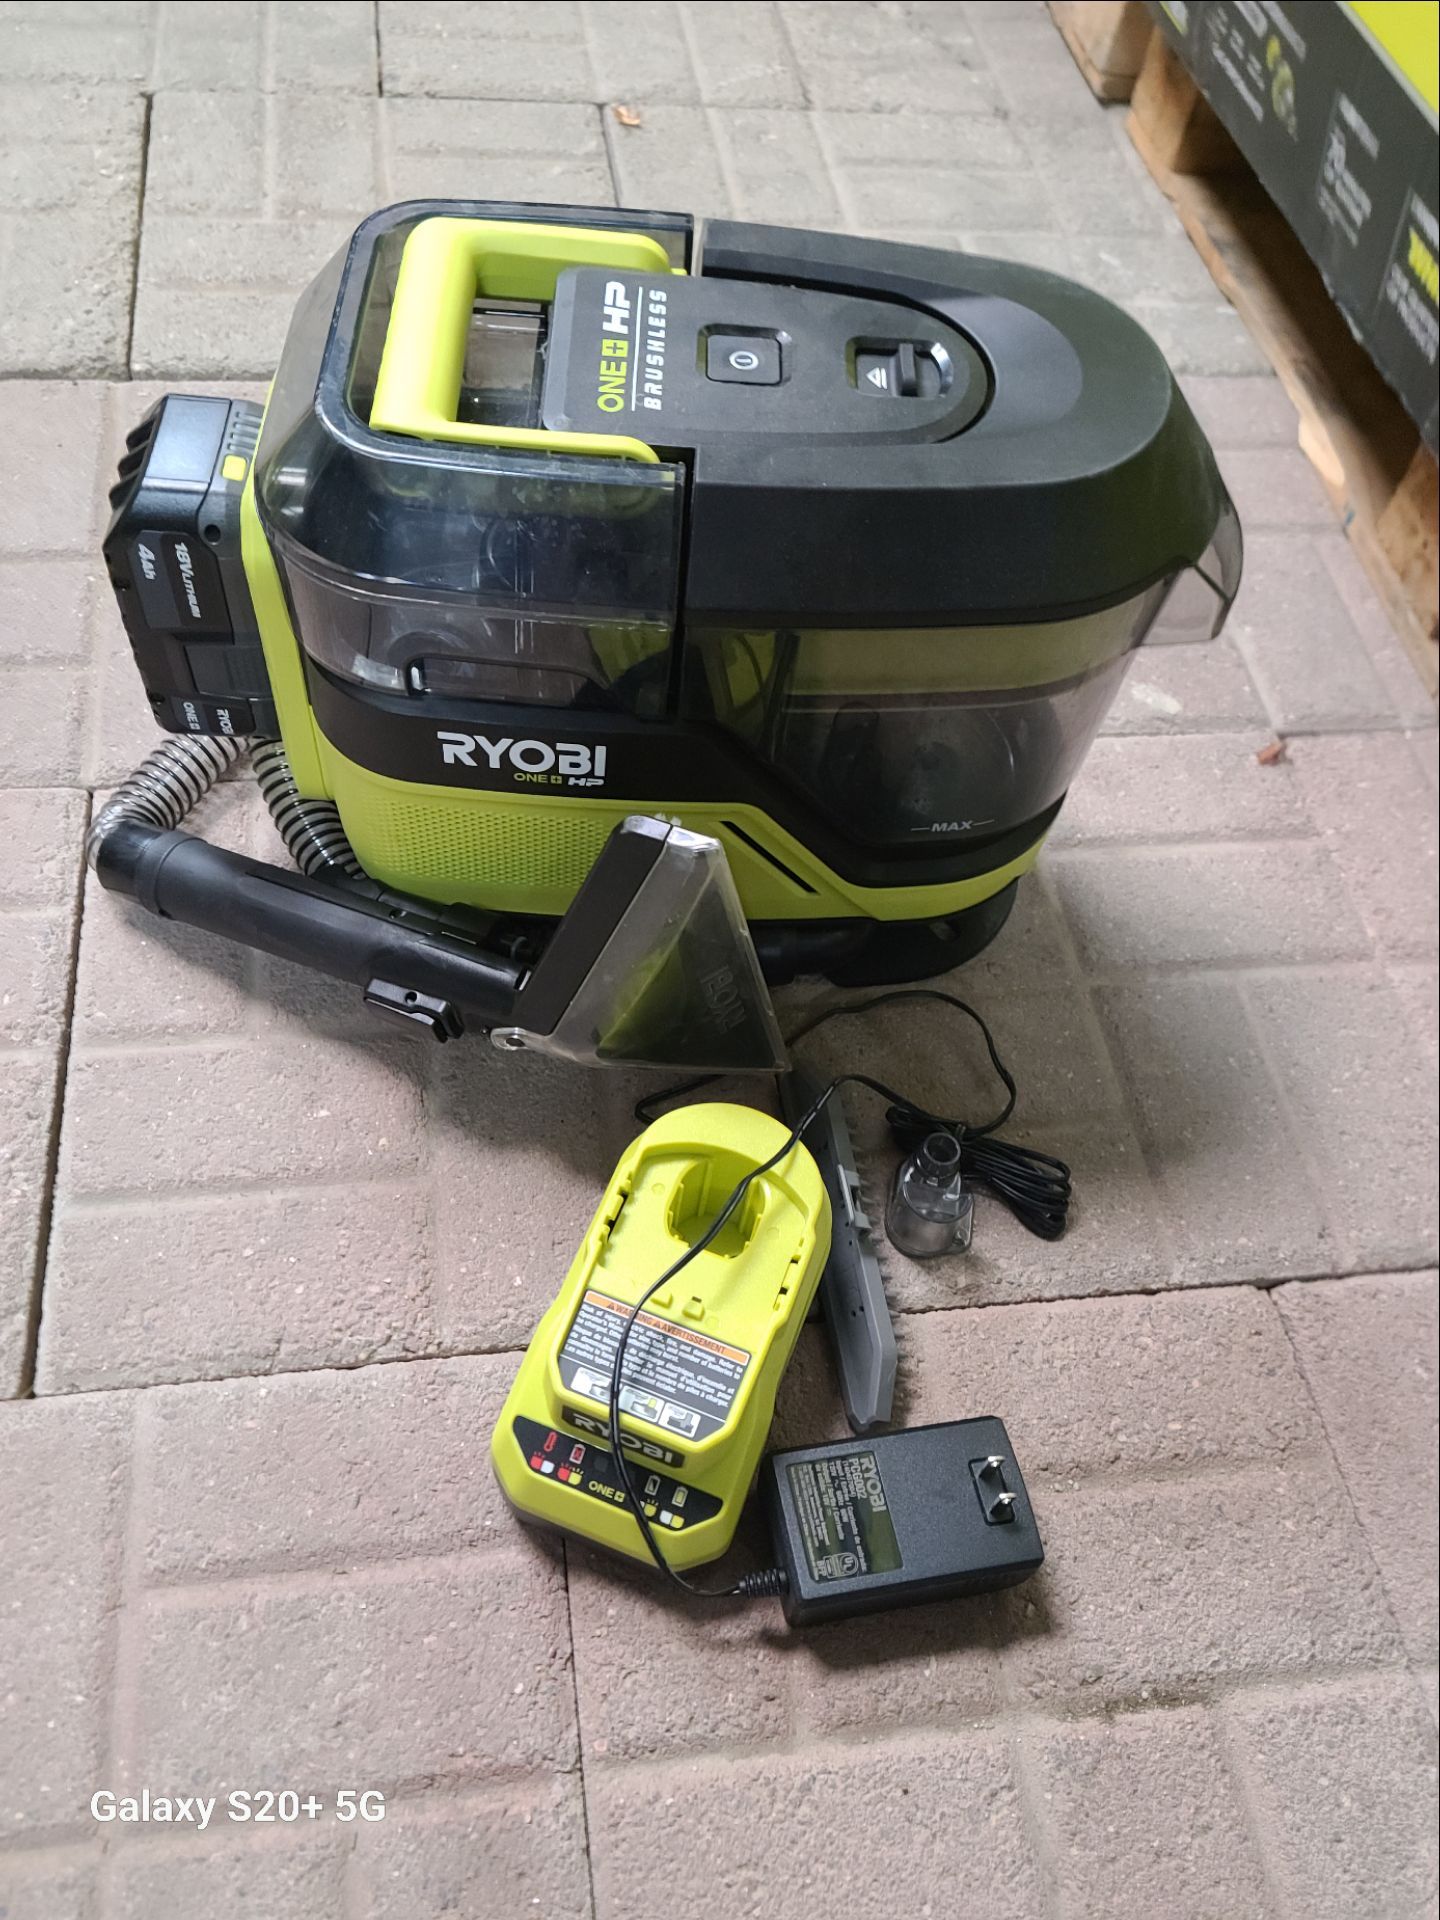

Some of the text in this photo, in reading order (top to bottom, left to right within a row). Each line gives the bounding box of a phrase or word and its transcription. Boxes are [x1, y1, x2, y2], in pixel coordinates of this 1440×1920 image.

[602, 280, 631, 335] HP
[643, 289, 668, 411] BRUSHLESS
[436, 730, 607, 777] RYOBI
[567, 776, 605, 787] HP
[931, 820, 973, 832] MAX
[660, 1322, 726, 1354] AVERTISSEMENT
[858, 1455, 886, 1512] RYOBI
